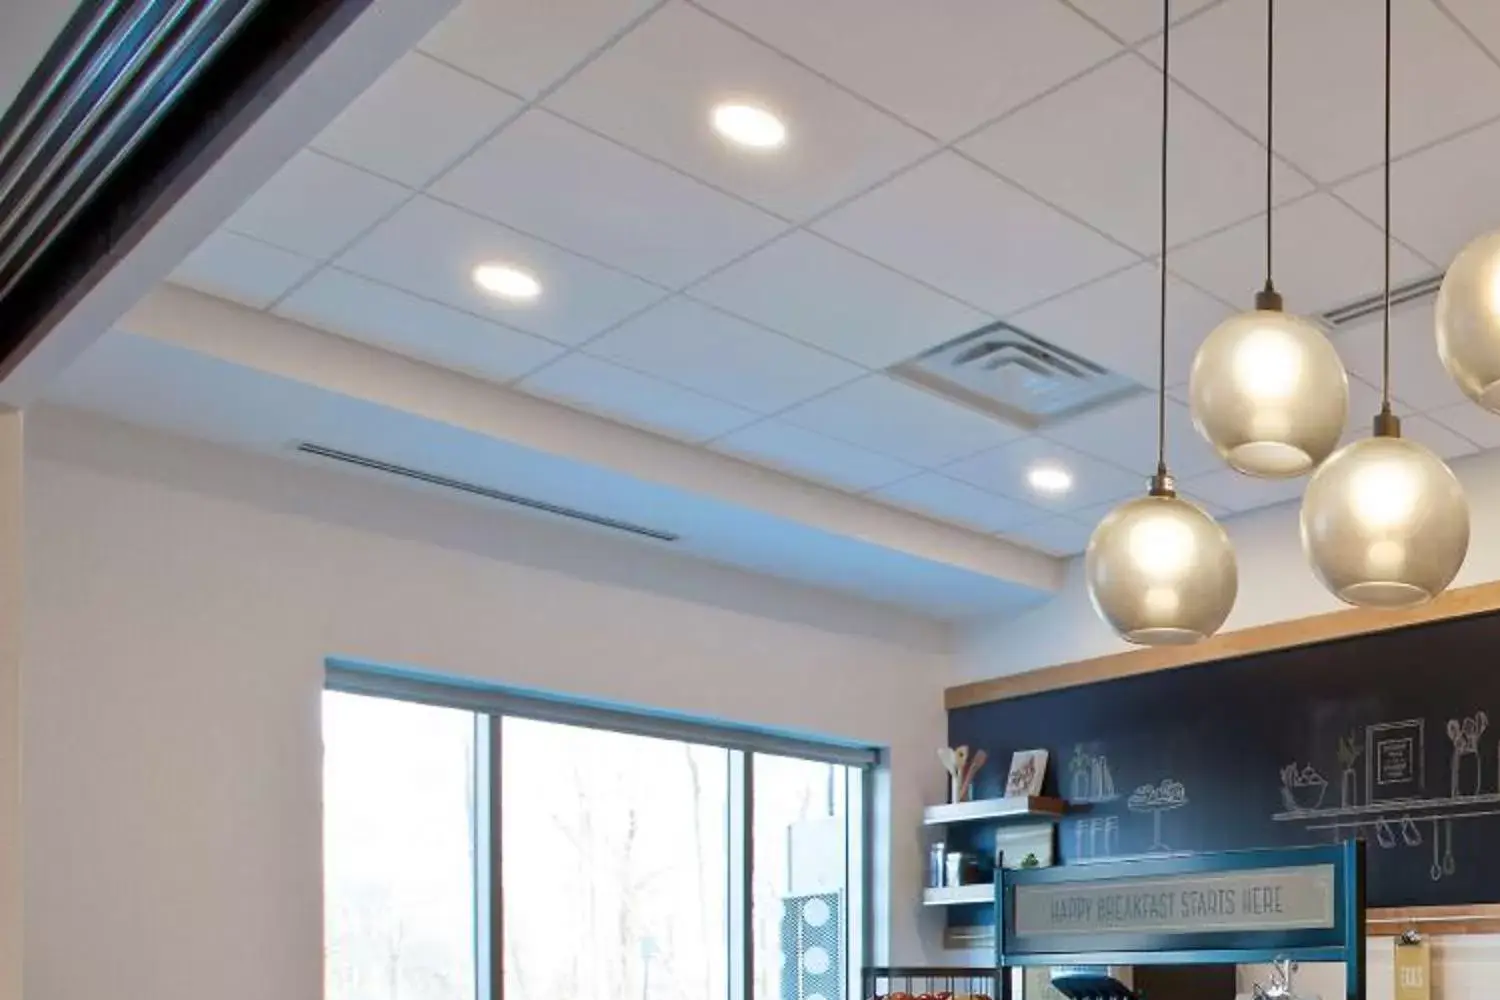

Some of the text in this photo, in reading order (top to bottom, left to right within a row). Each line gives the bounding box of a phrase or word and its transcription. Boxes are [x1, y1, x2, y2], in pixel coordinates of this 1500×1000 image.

[1051, 886, 1283, 922] HAPPY BREAKFAST STARTS HERE
